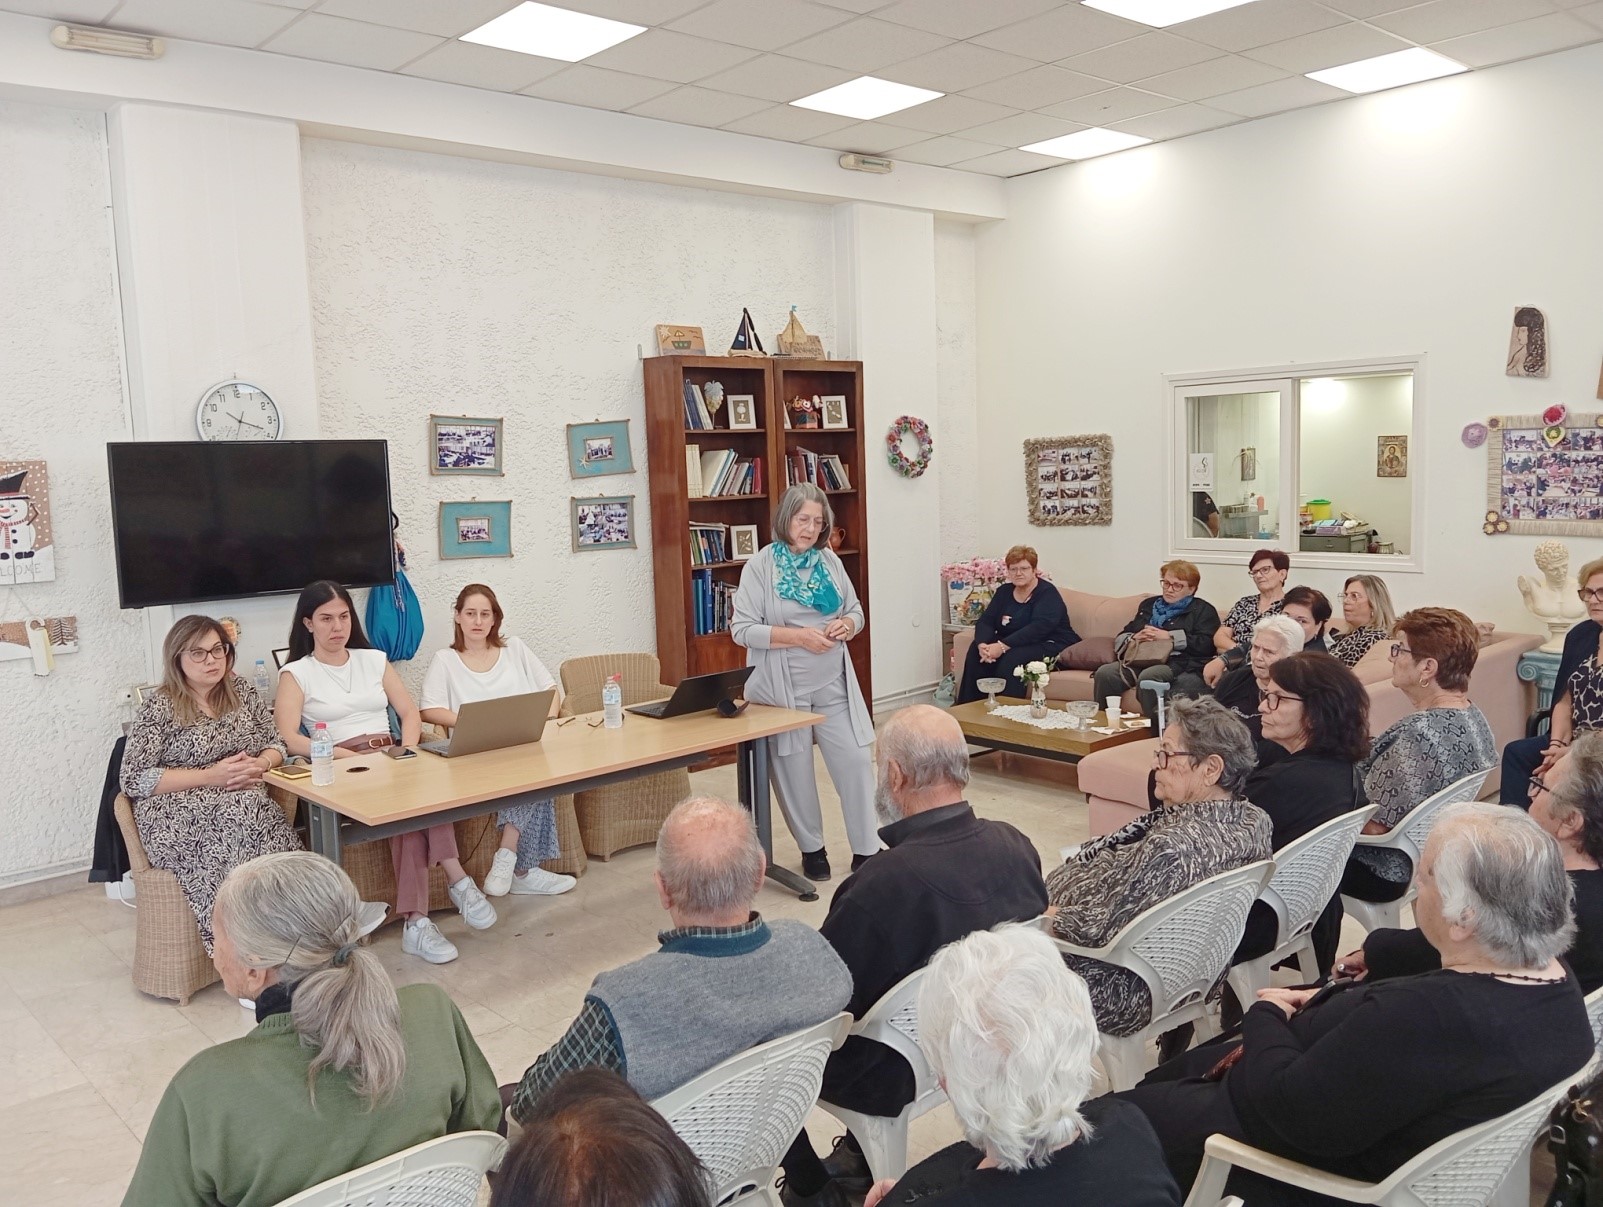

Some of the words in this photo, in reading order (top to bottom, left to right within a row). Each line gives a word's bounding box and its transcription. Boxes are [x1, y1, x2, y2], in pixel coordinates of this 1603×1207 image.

[218, 394, 226, 402] 11
[233, 390, 240, 398] 12
[209, 404, 218, 412] 10
[260, 402, 266, 410] 2
[267, 416, 272, 424] 3
